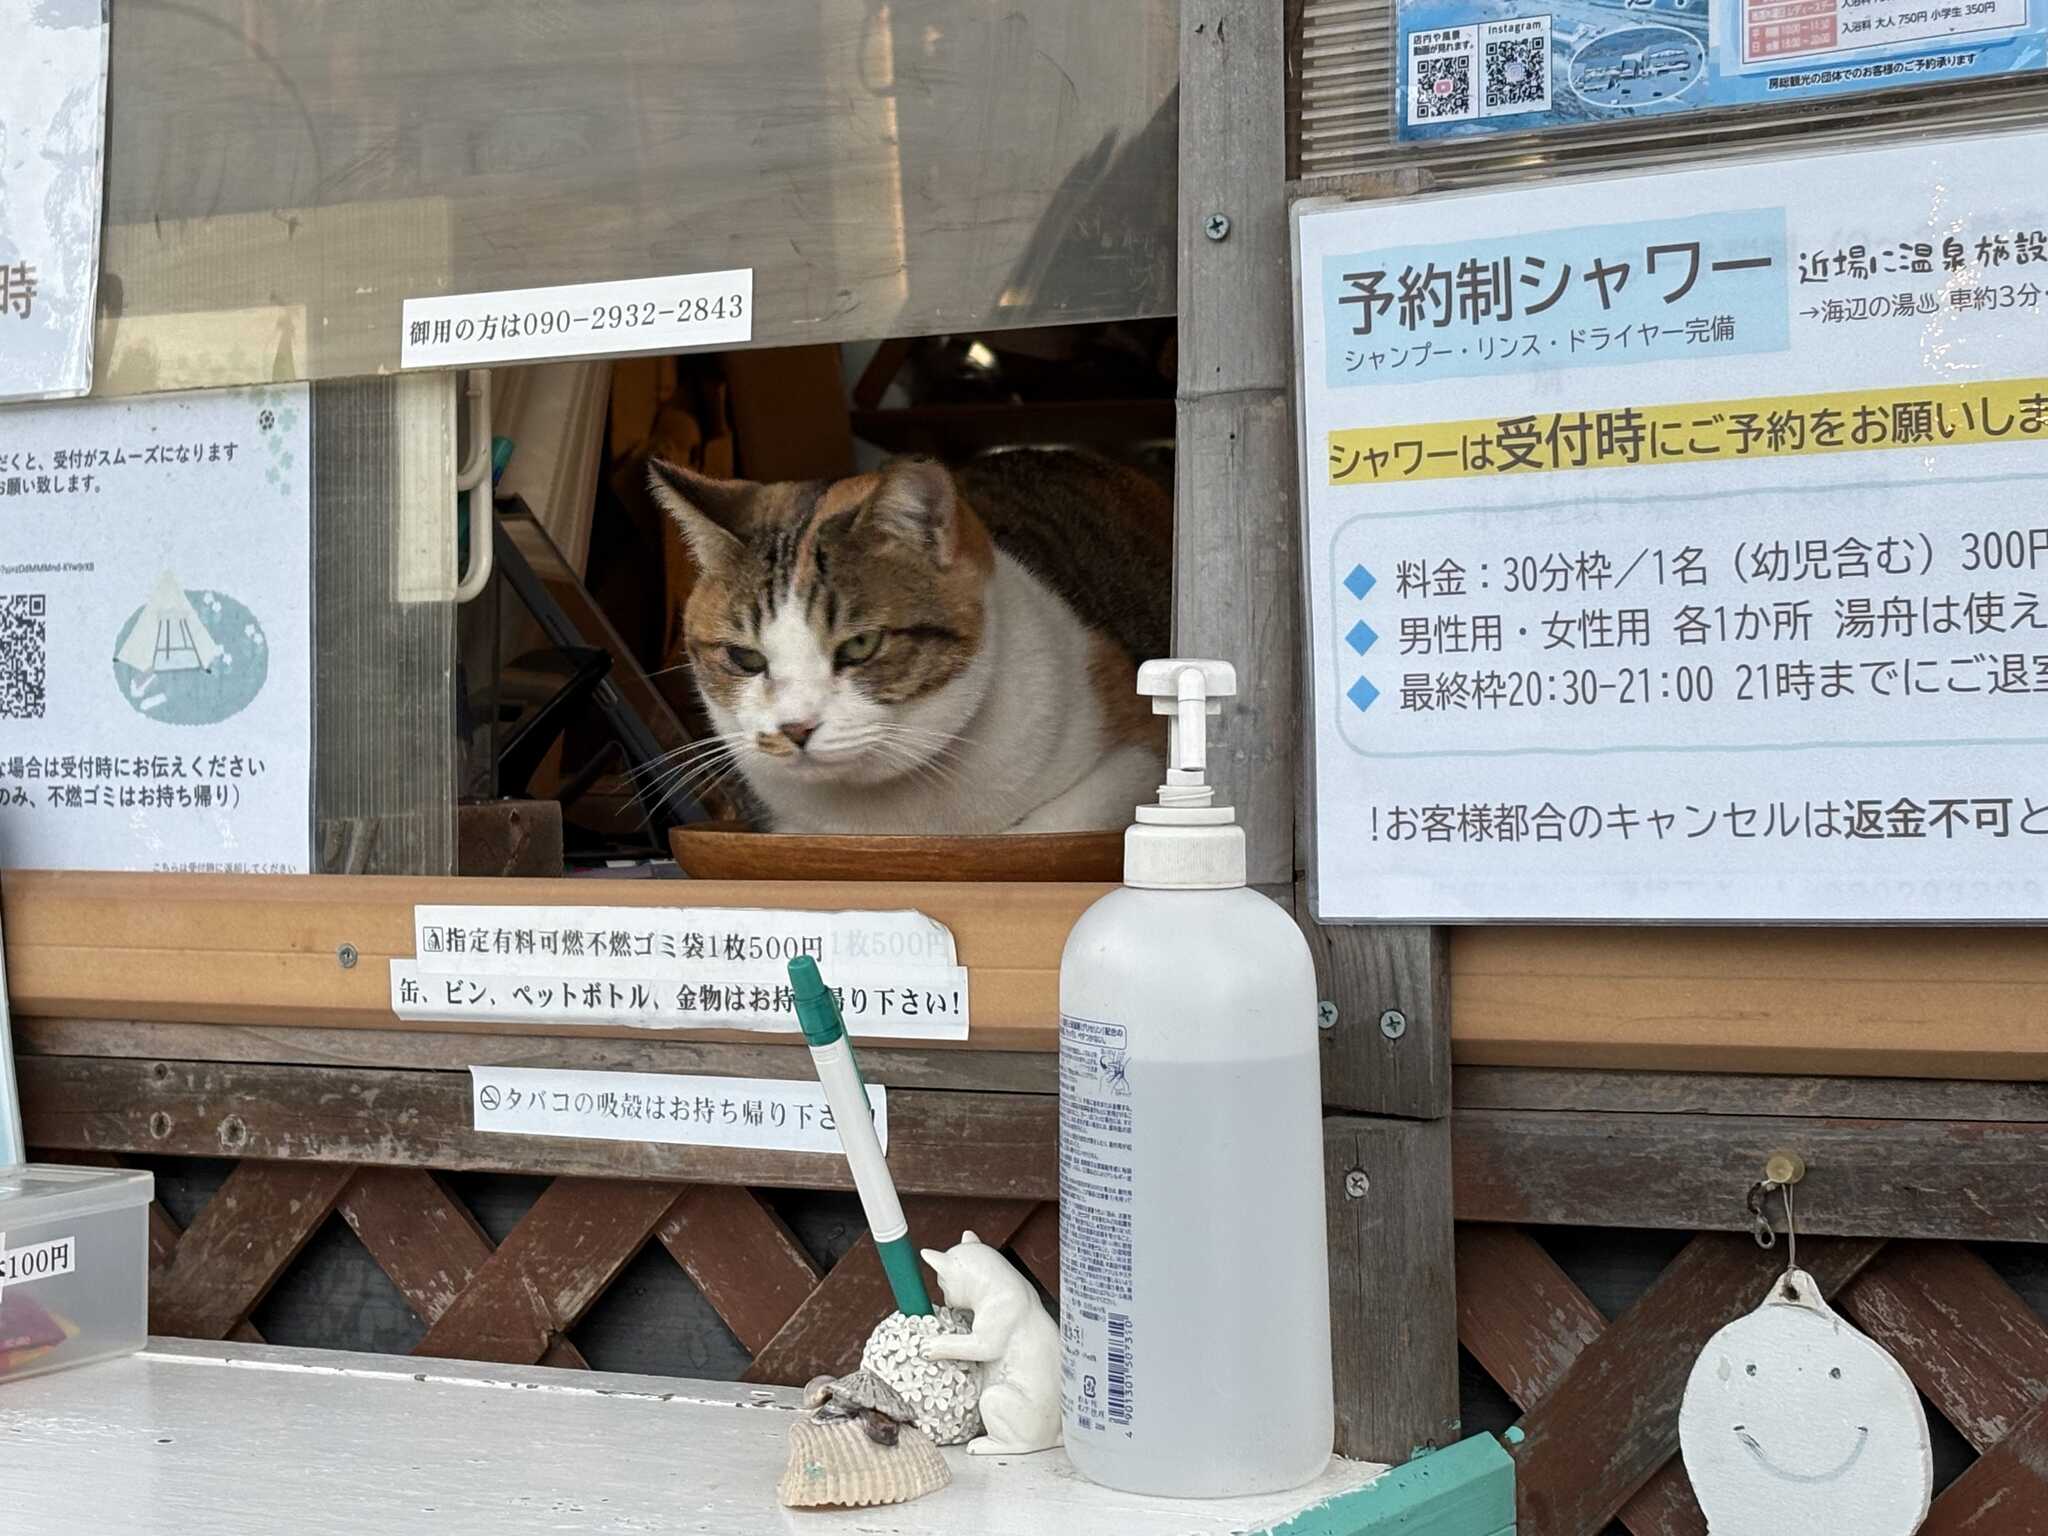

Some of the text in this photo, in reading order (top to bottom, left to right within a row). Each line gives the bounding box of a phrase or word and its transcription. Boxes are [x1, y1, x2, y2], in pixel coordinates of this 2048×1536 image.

[1488, 21, 1542, 35] Instagram
[1875, 16, 1896, 29] 大人
[1898, 11, 1928, 24] 750円
[1930, 6, 1962, 21] 小学生
[1965, 1, 1996, 16] 350円
[1338, 241, 1773, 336] 予約制シャワー
[410, 294, 743, 346] 御用の方は090-2932-2843
[1345, 314, 1736, 373] シャンプー・リンス・ドライヤー完備
[1400, 591, 2048, 656] 男性用・女性用 各1か所 湯舟は使え
